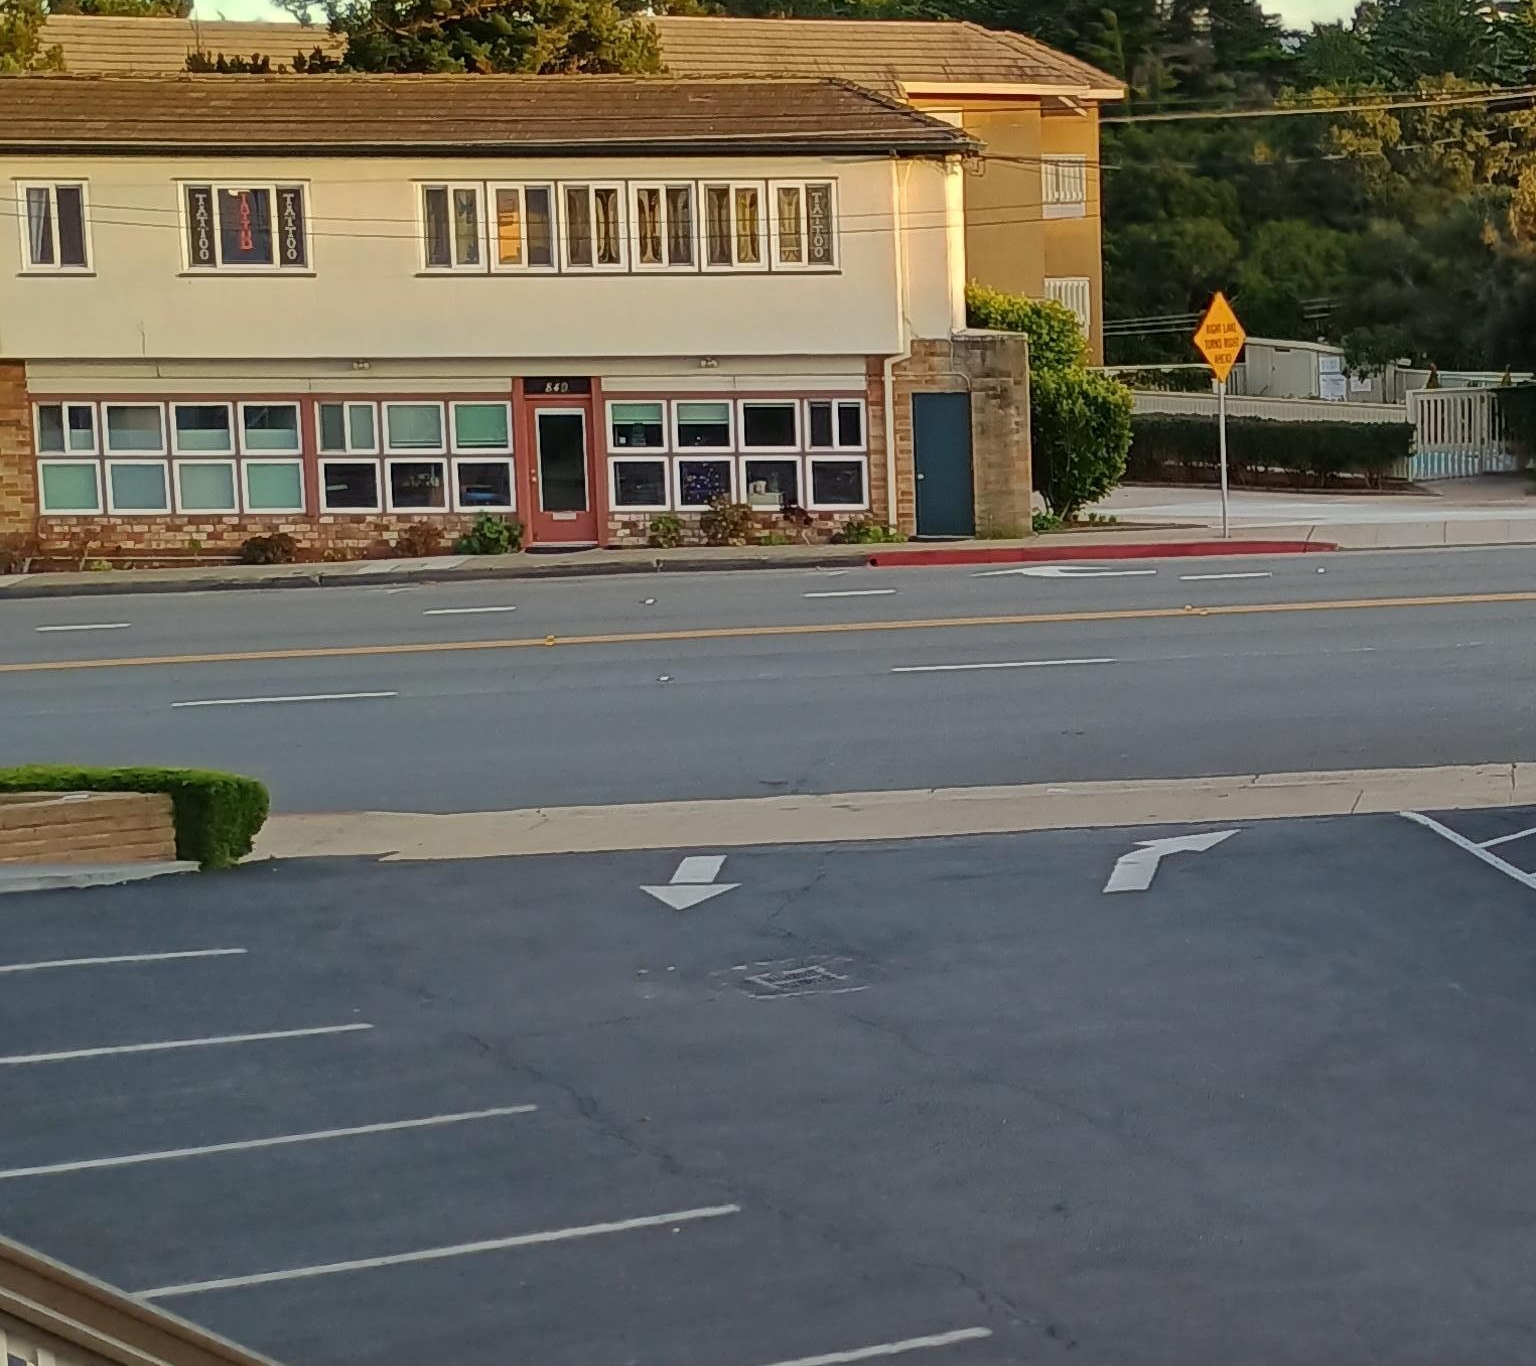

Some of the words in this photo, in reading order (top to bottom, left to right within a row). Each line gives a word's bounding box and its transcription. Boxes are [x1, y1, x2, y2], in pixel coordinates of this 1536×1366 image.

[195, 193, 210, 260] TATTOO
[282, 193, 298, 260] TATTOO
[811, 192, 824, 258] TATTOO
